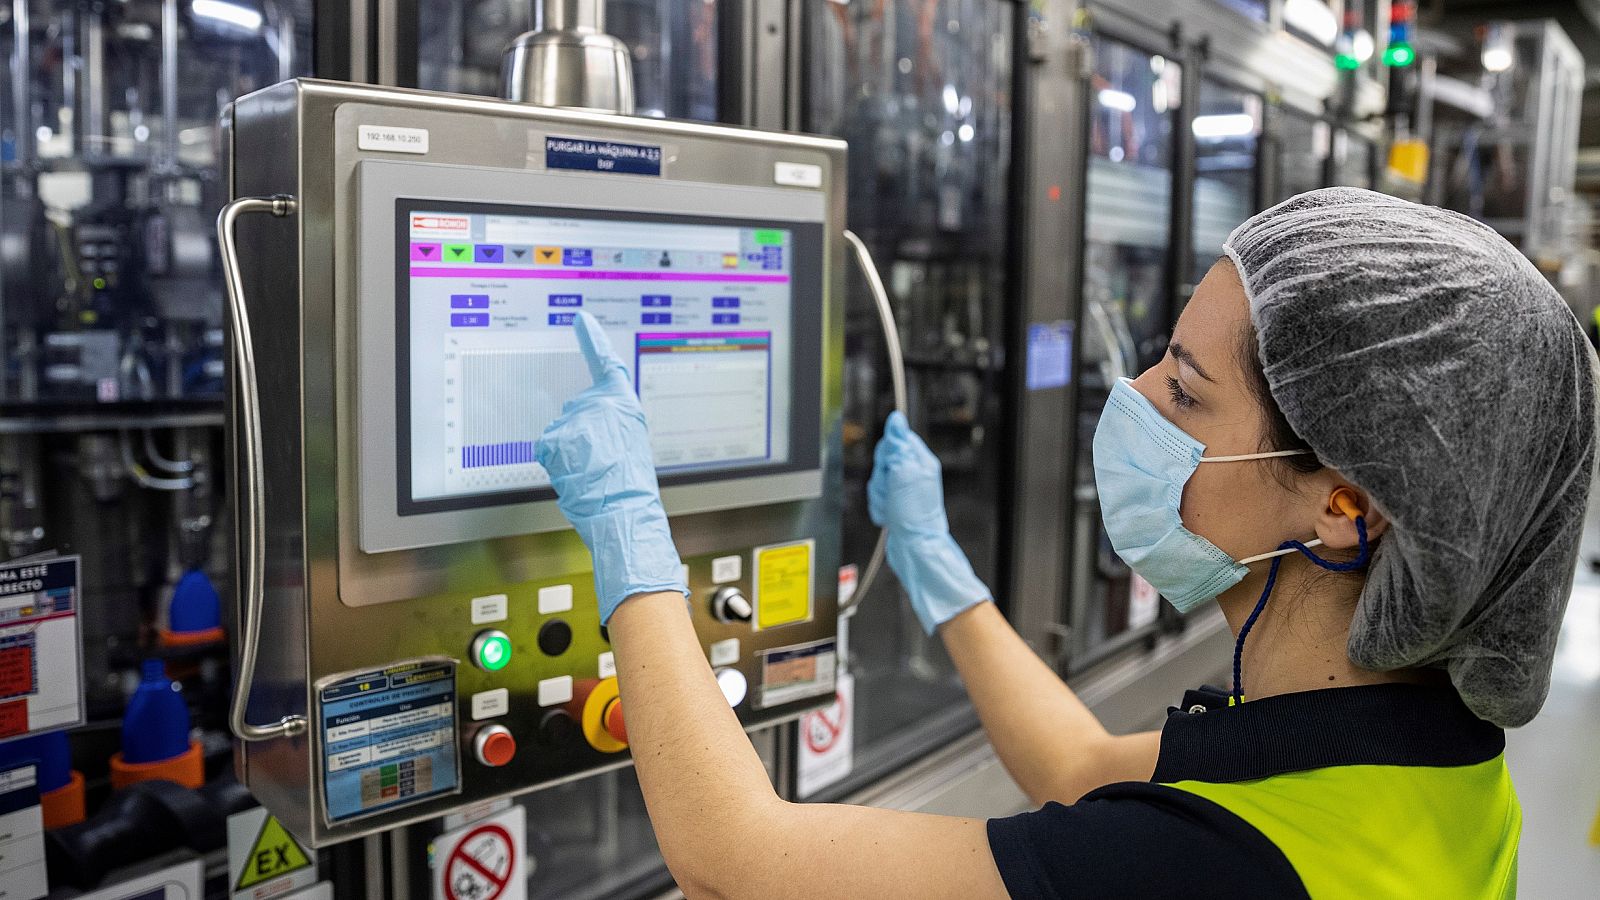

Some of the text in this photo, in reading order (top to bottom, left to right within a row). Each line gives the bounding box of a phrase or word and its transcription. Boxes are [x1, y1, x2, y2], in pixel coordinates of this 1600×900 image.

[547, 140, 584, 153] PURGAR
[585, 145, 597, 154] LA
[257, 843, 289, 875] EX
